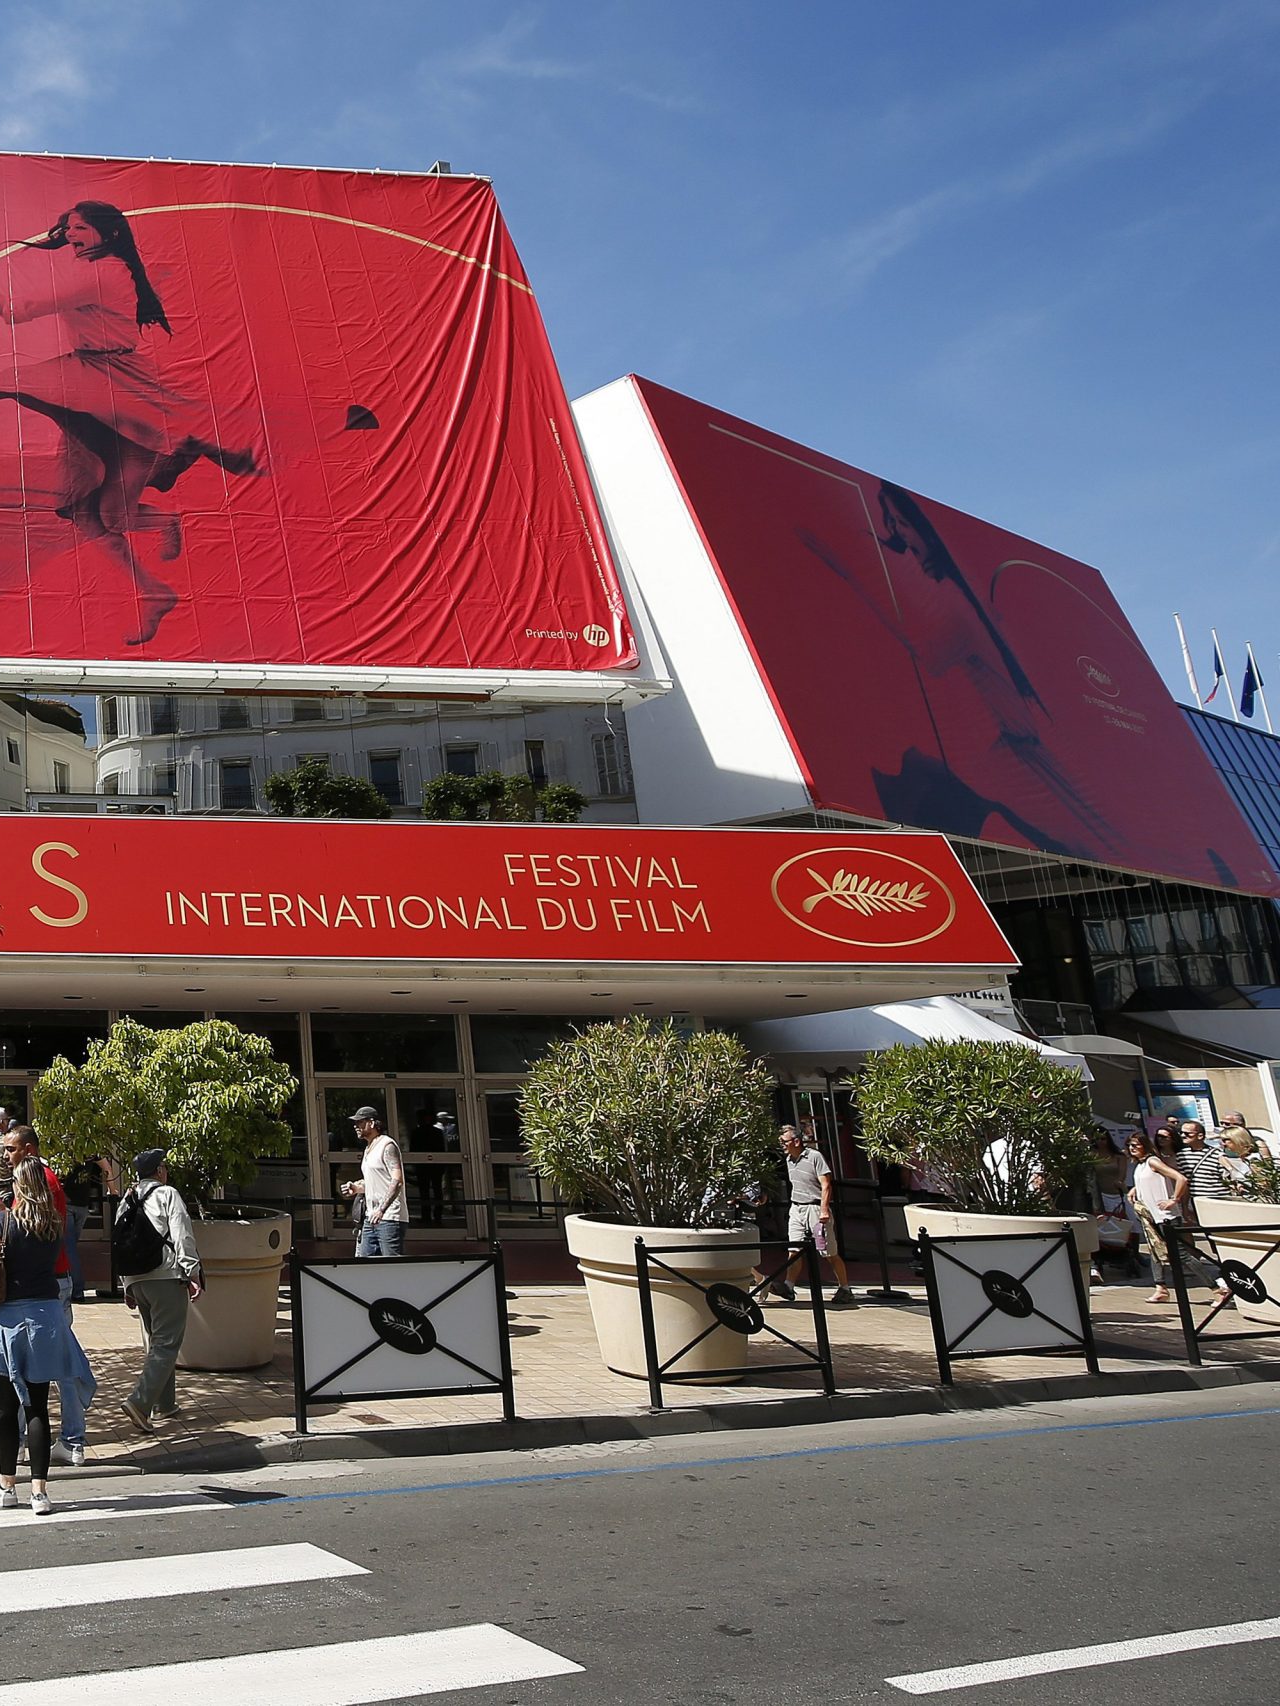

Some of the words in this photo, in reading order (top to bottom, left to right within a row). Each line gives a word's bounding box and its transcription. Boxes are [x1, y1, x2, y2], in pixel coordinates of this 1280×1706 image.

[525, 628, 564, 639] Printed
[583, 624, 610, 647] hp
[504, 854, 698, 889] FESTIVAL
[165, 891, 526, 930] INTERNATIONAL
[536, 898, 597, 931] DU
[609, 899, 711, 933] FILM
